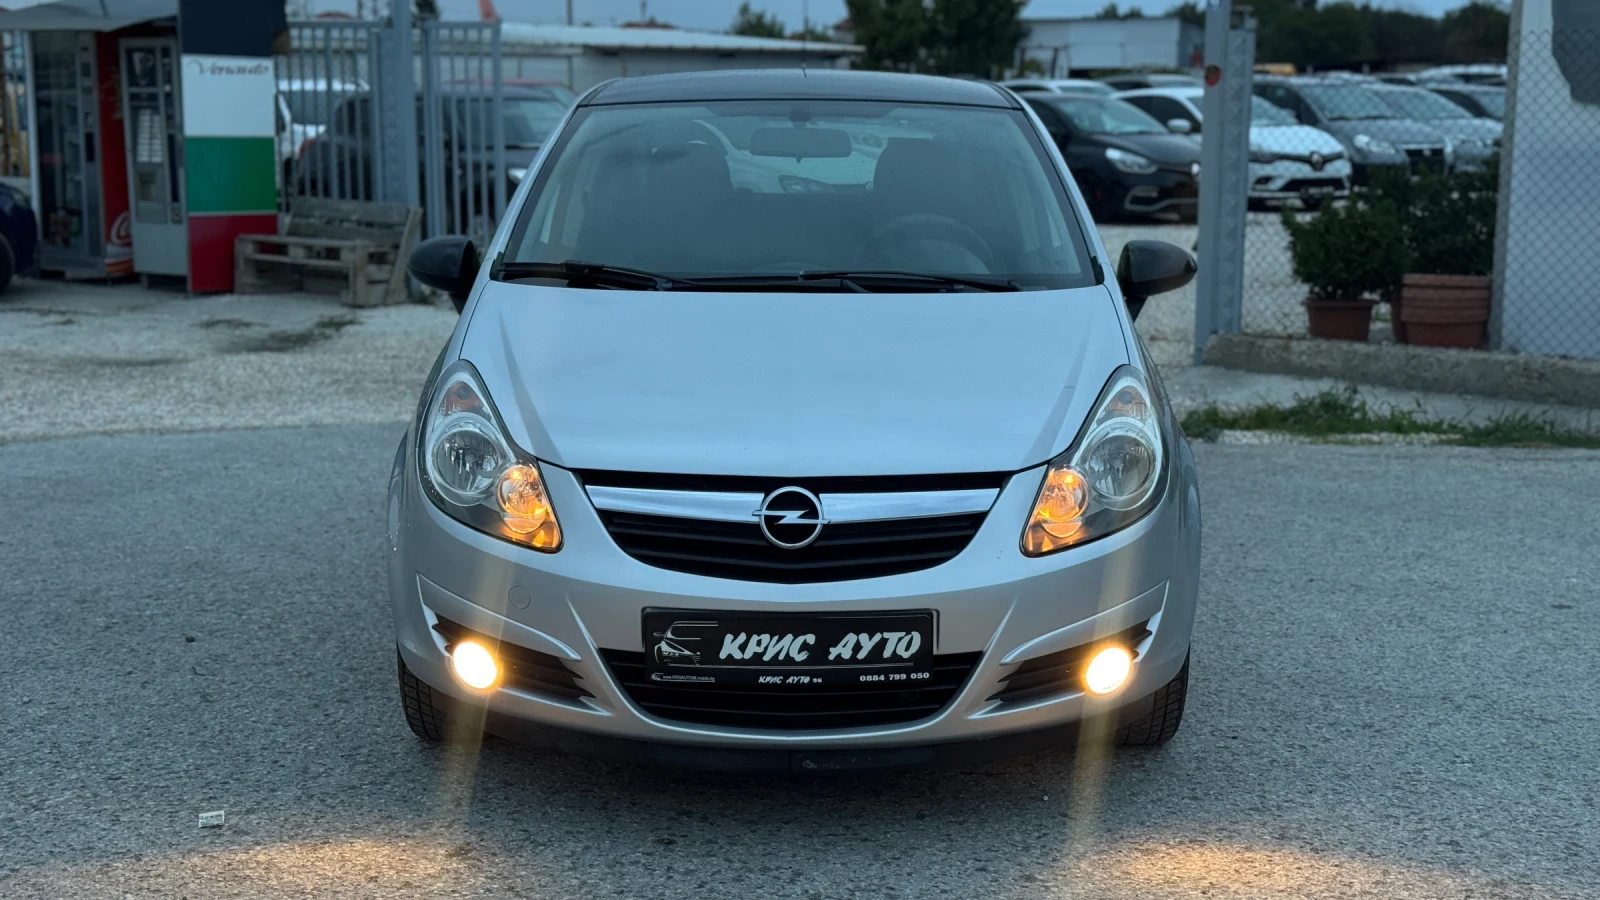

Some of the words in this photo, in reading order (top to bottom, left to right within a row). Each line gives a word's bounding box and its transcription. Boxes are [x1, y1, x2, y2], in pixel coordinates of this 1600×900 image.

[718, 631, 816, 662] КРИС
[827, 630, 922, 661] АУТО
[758, 675, 784, 684] КРИС
[785, 675, 811, 684] АУТО
[859, 673, 885, 682] 0884
[888, 673, 907, 681] 799
[910, 671, 930, 680] 050
